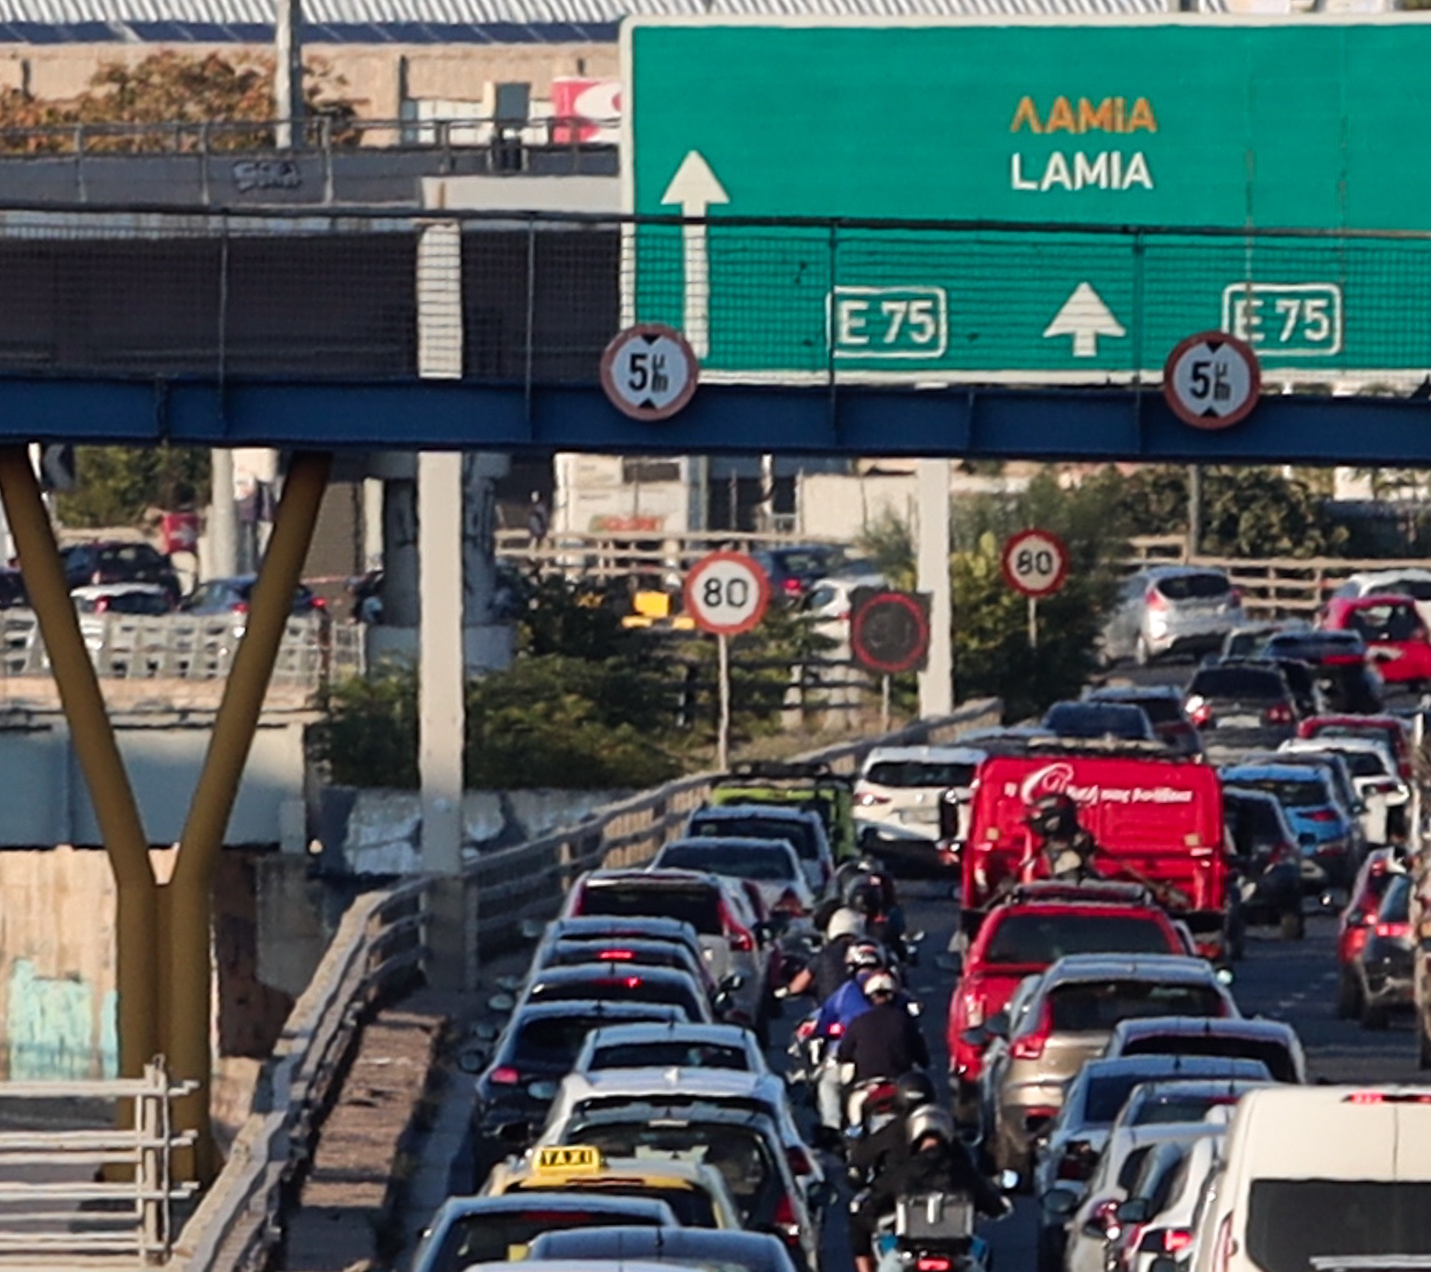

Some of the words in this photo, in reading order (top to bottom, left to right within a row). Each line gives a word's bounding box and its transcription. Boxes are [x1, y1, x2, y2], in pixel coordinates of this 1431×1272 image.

[1010, 95, 1158, 134] ΛΑΜΙΑ
[1011, 150, 1155, 192] LAMIA
[839, 301, 870, 344] E
[880, 301, 936, 344] 75
[1234, 299, 1265, 342] E
[1275, 299, 1330, 342] 75
[628, 353, 649, 392] 5
[1189, 359, 1212, 400] 5
[1016, 548, 1054, 576] 80
[702, 576, 750, 609] 80
